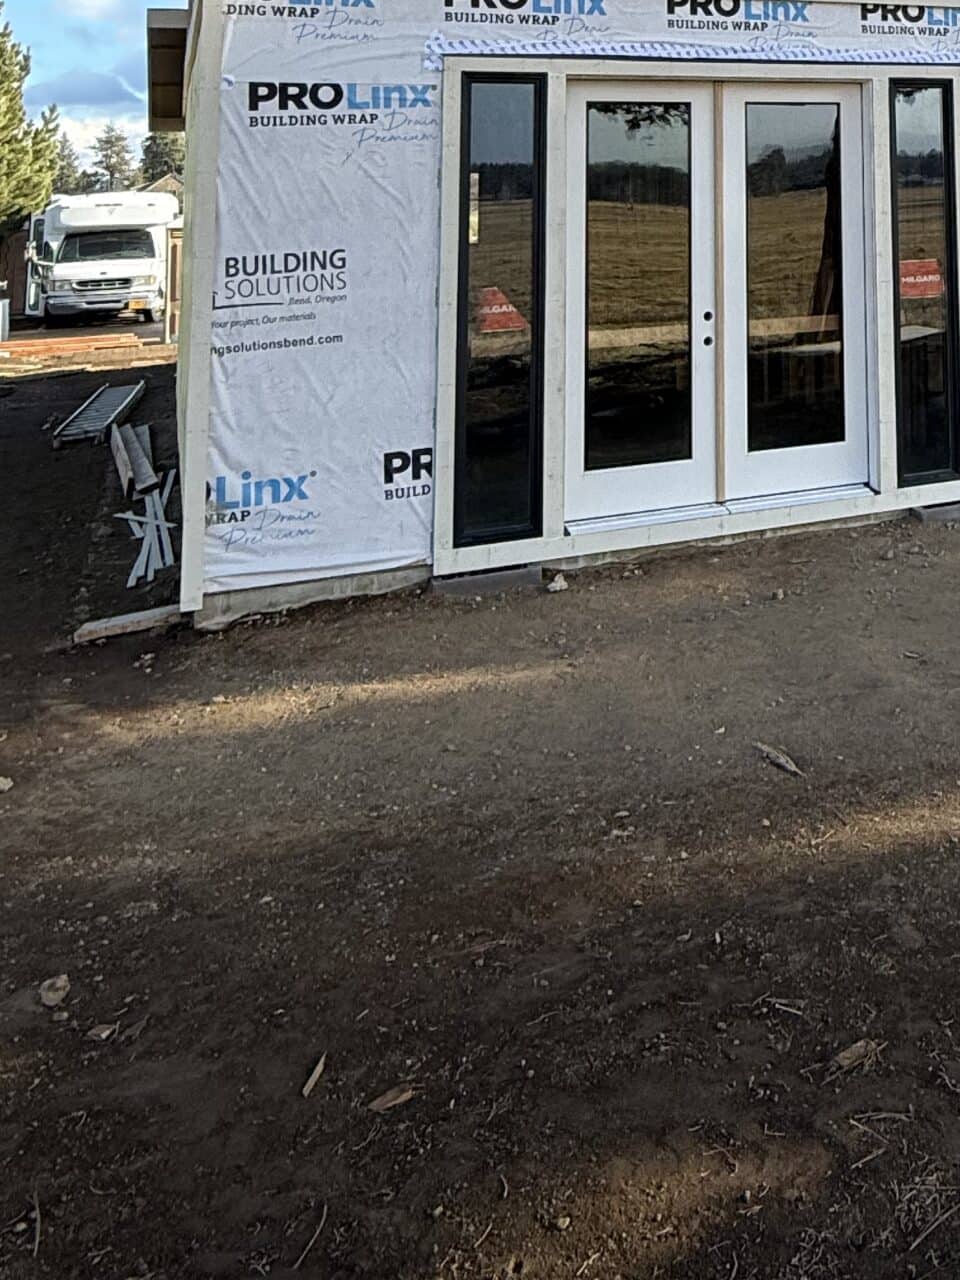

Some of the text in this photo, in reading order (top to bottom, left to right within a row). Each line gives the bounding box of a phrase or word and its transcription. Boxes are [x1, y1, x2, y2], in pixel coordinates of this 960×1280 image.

[271, 6, 320, 18] WRAP
[322, 7, 385, 30] Drain
[444, 12, 560, 26] BUILDING WRAP
[667, 20, 768, 32] BUILDING WRAP
[861, 25, 950, 37] BUILDING WRAP
[248, 82, 432, 111] PROLinx
[250, 113, 379, 128] BUILDING WRAP
[383, 109, 439, 131] Drain
[225, 249, 346, 278] BUILDING
[225, 271, 347, 300] SOLUTIONS
[315, 294, 347, 305] Oregon
[210, 334, 343, 358] ngsolutionsbend.com
[206, 471, 309, 509] Linx
[384, 484, 431, 500] BUILD
